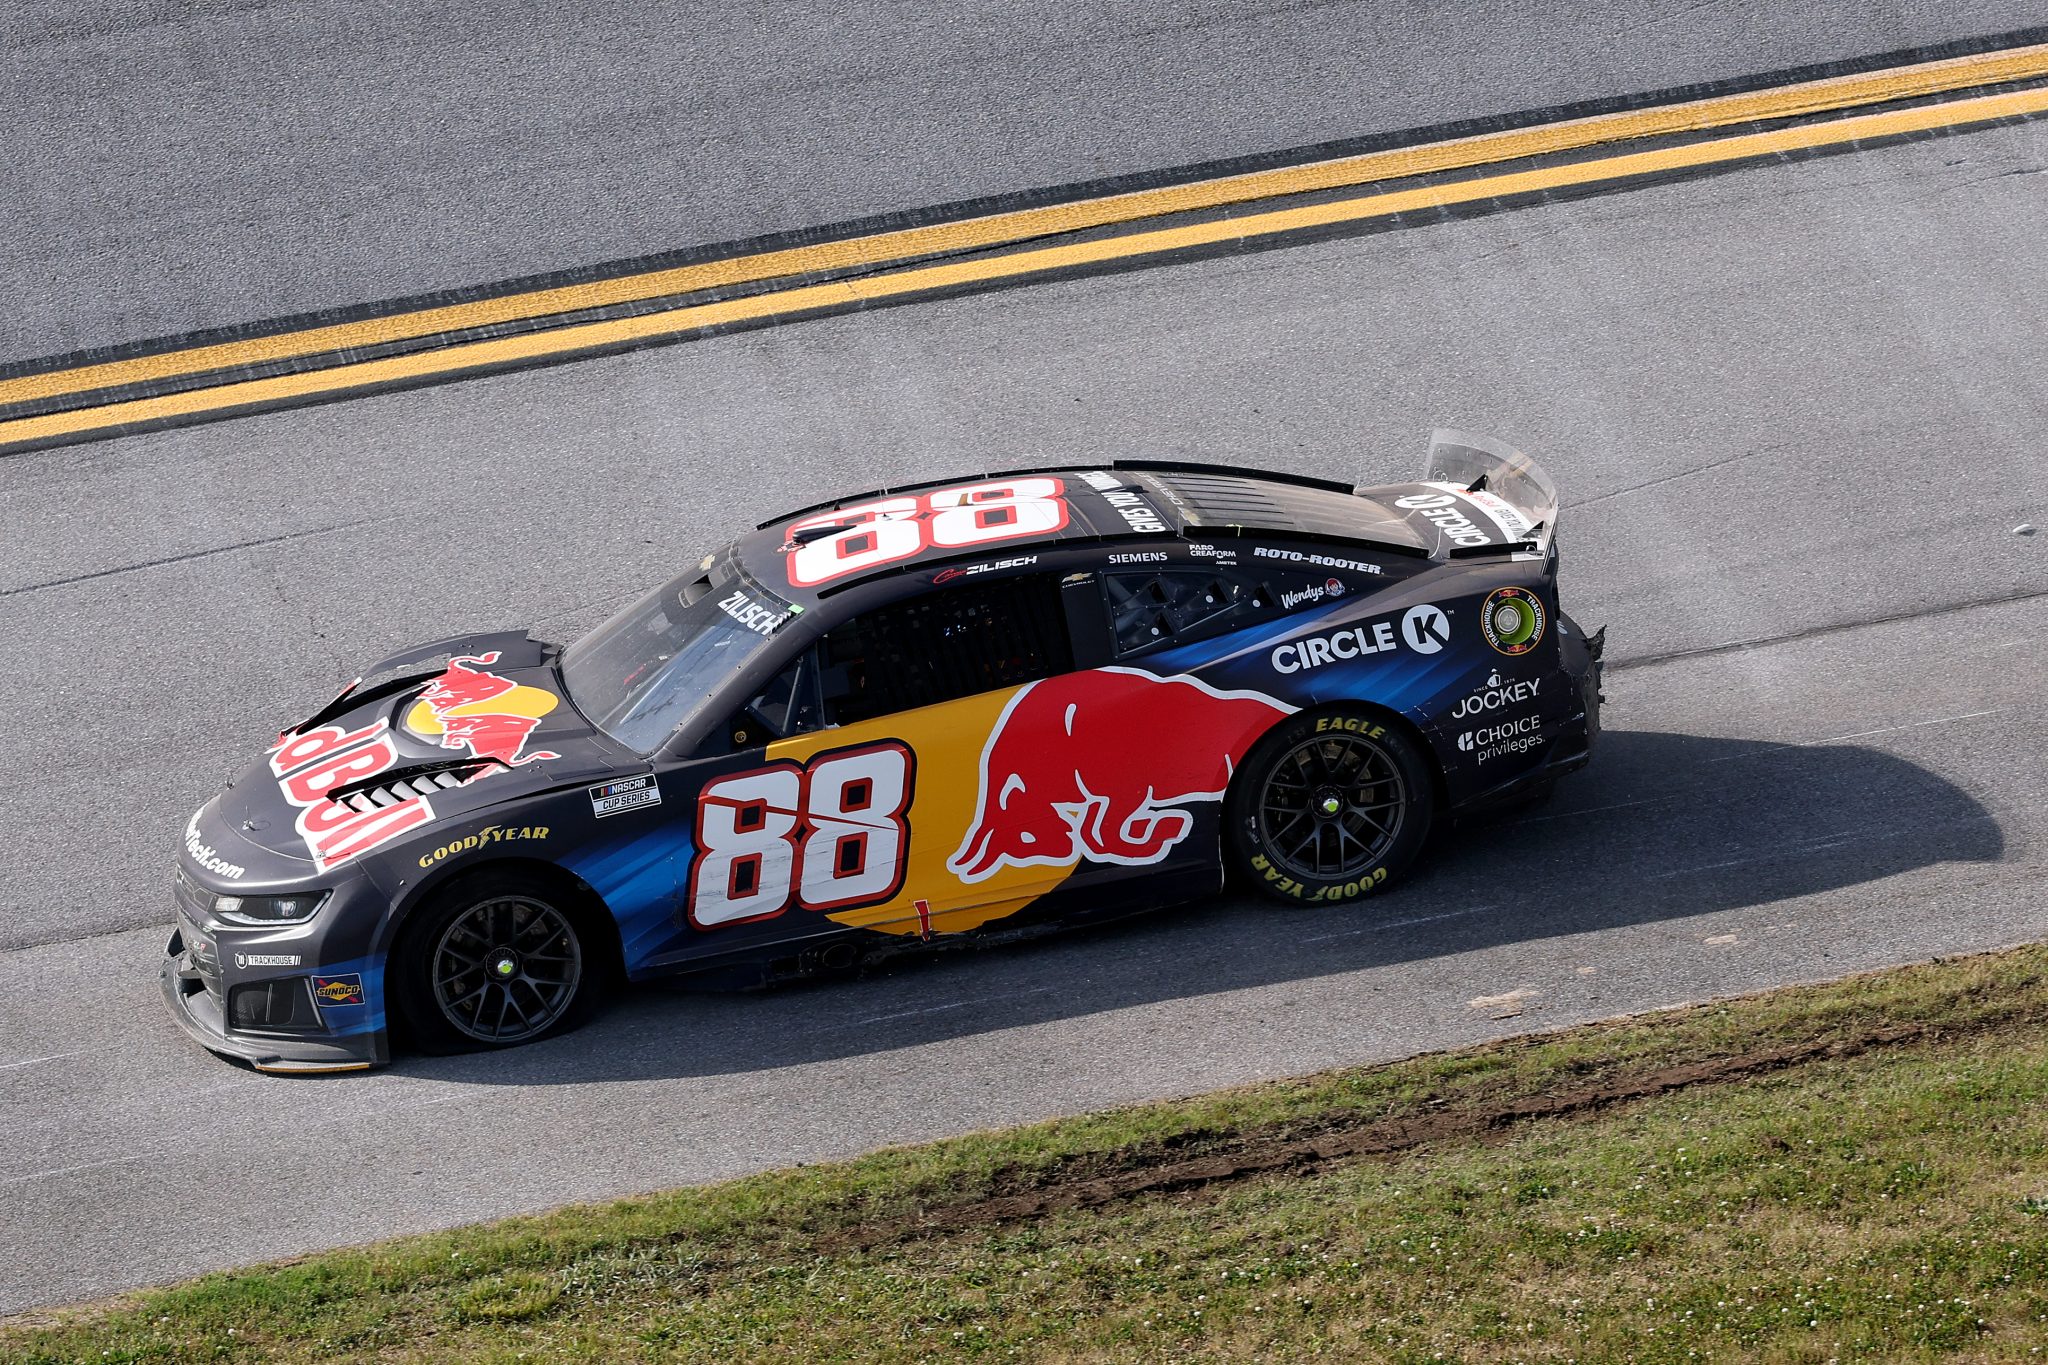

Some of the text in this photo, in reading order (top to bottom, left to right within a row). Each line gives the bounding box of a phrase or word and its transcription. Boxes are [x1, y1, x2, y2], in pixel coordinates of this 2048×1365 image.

[785, 477, 1069, 588] 88
[1118, 508, 1167, 533] GIVES
[1420, 508, 1492, 547] CIRCLE
[966, 555, 1039, 576] ZILISCH
[1108, 551, 1168, 564] SIEMENS
[1190, 550, 1237, 559] CREAFORM
[1253, 546, 1382, 575] ROTO-ROOTER
[717, 590, 779, 636] ZILISCH
[1484, 600, 1500, 647] TRACKHOUSE
[1527, 595, 1542, 641] TRACKHOUSE
[1271, 621, 1397, 674] CIRCLE
[1407, 607, 1449, 651] K
[1451, 677, 1540, 719] JOCKEY
[1315, 717, 1386, 739] EAGLE
[1475, 715, 1540, 745] CHOICE
[1477, 734, 1543, 765] privileges
[603, 791, 651, 810] CUP SERIES
[611, 778, 647, 795] NASCAR
[688, 743, 911, 931] 88
[250, 955, 293, 965] TRACKHOUSE
[318, 985, 359, 996] SUNOCO
